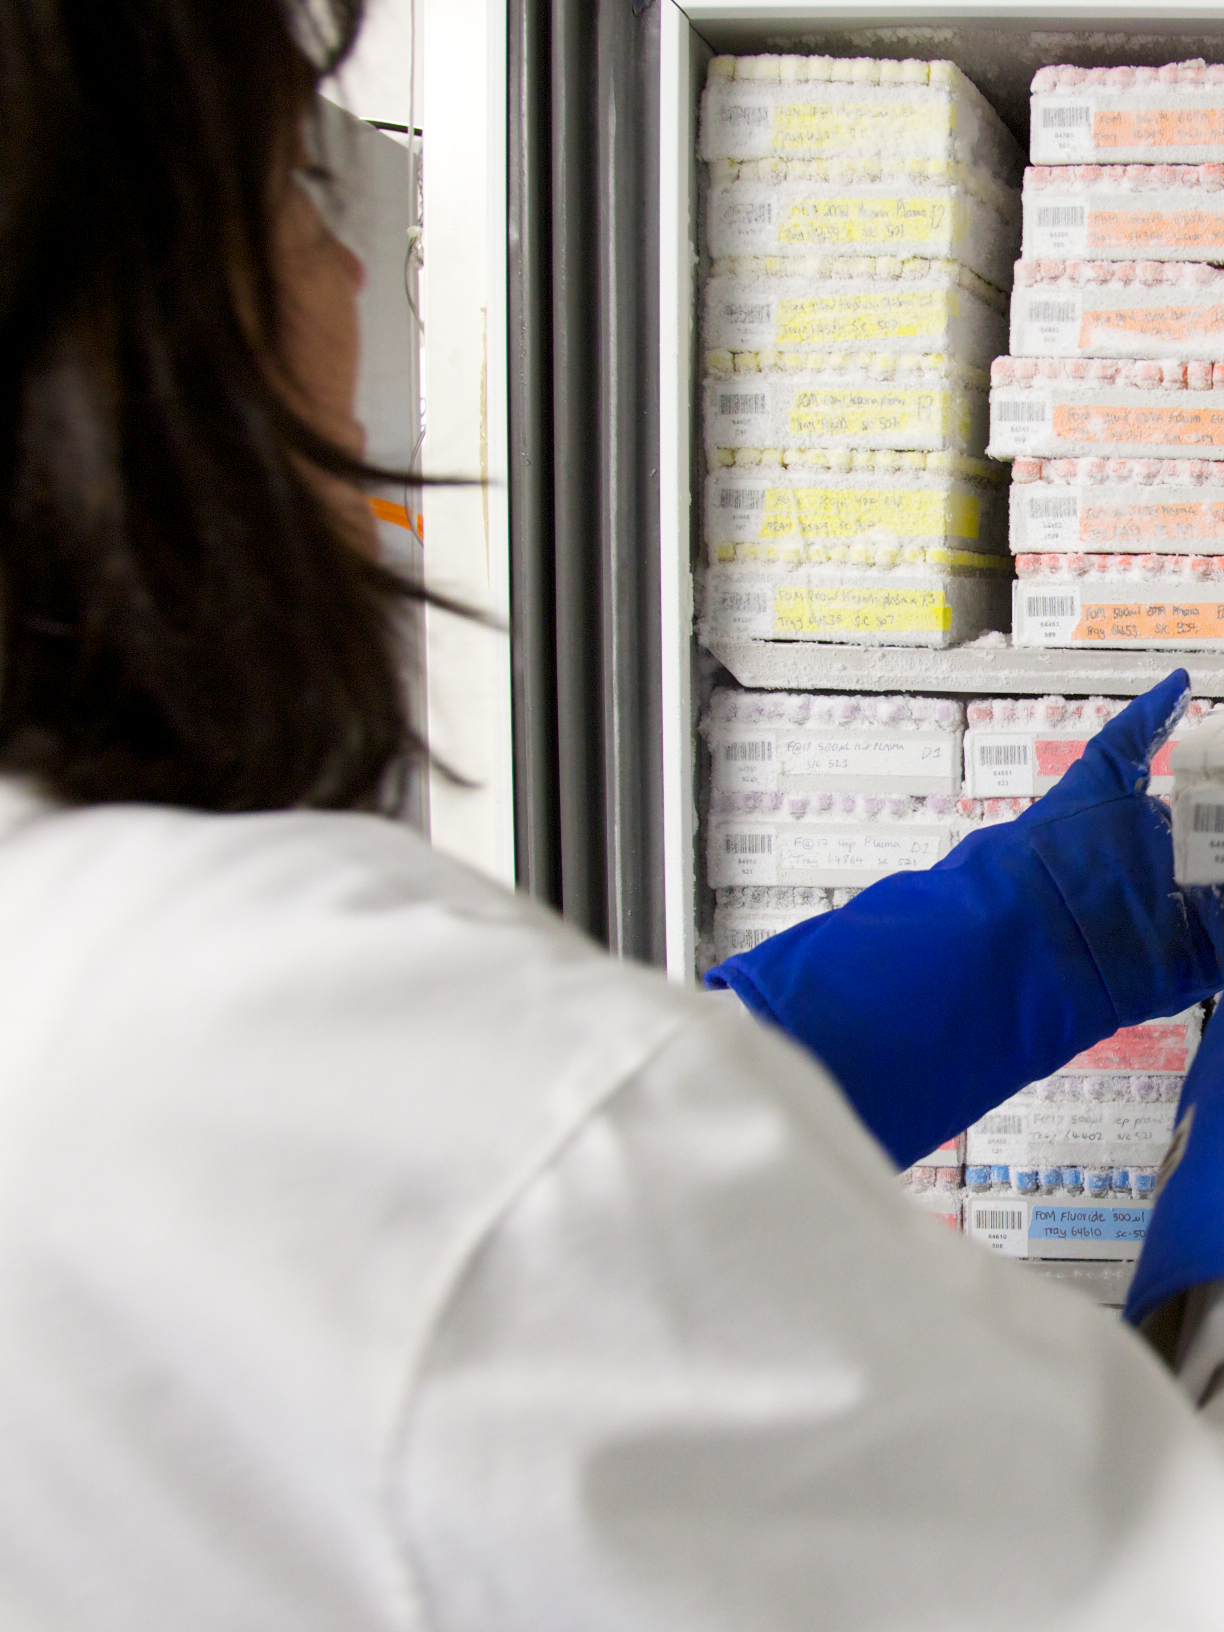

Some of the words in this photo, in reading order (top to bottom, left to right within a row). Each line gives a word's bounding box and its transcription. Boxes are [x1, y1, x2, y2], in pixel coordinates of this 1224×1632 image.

[1085, 606, 1107, 622] FOM
[1040, 621, 1060, 629] 64453
[1044, 631, 1057, 640] 509
[1085, 626, 1107, 641] Tray
[921, 745, 943, 761] D1
[827, 757, 850, 770] 521
[863, 834, 902, 849] Plasma
[826, 852, 865, 866] 64864
[1063, 1130, 1104, 1142] 64402
[1034, 1210, 1057, 1222] FOM
[1060, 1209, 1107, 1223] Fluoride
[987, 1232, 1008, 1241] 64610
[1043, 1226, 1068, 1238] Tray
[1070, 1225, 1103, 1237] 64610
